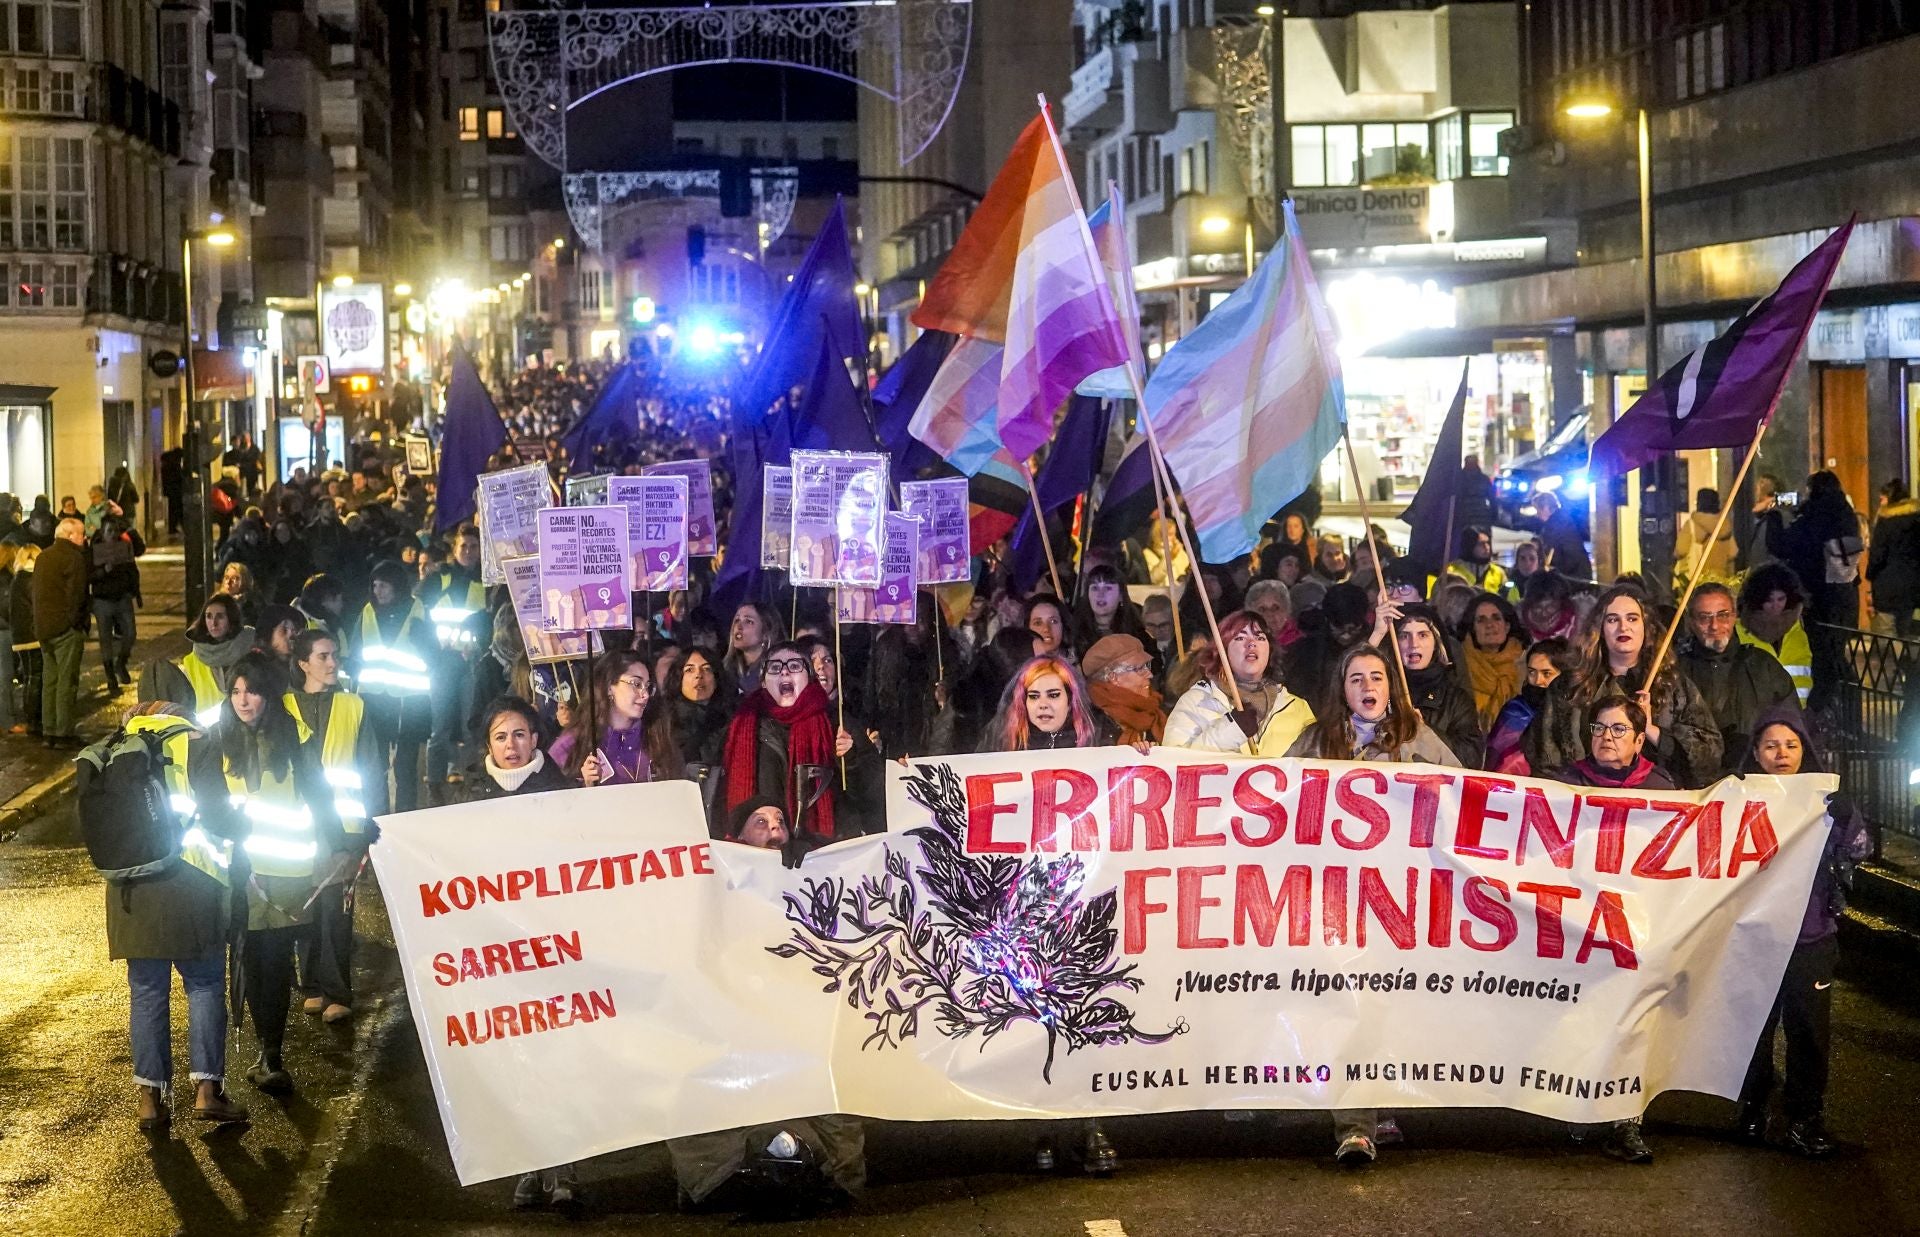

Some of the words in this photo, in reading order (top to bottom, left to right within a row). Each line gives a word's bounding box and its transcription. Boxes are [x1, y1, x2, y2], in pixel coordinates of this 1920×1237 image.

[1363, 191, 1425, 211] Dental
[617, 486, 640, 496] CARME
[550, 516, 576, 526] CARME
[581, 515, 594, 527] NO
[582, 528, 616, 537] RECORTES
[646, 524, 666, 540] EZ!
[889, 546, 907, 554] TIMAS
[583, 554, 622, 564] VIOLENCIA
[887, 555, 911, 564] LENCIA
[584, 564, 622, 575] MACHISTA
[886, 565, 911, 574] CHISTA
[966, 763, 1780, 880] ERRESISTENTZIA
[418, 843, 715, 918] KONPLIZITATE
[1123, 864, 1640, 971] FEMINISTA
[433, 930, 583, 987] SAREEN
[1175, 970, 1281, 1002] ¡Vuestra
[1291, 967, 1417, 997] hipocresía
[1425, 972, 1454, 993] es
[1463, 970, 1581, 1004] violencia!
[446, 988, 617, 1047] AURREAN
[1092, 1068, 1190, 1093] EUSKAL
[1205, 1064, 1331, 1085] HERRIKO
[1346, 1063, 1505, 1086] MUGIMENDU
[1520, 1066, 1643, 1100] FEMINISTA
